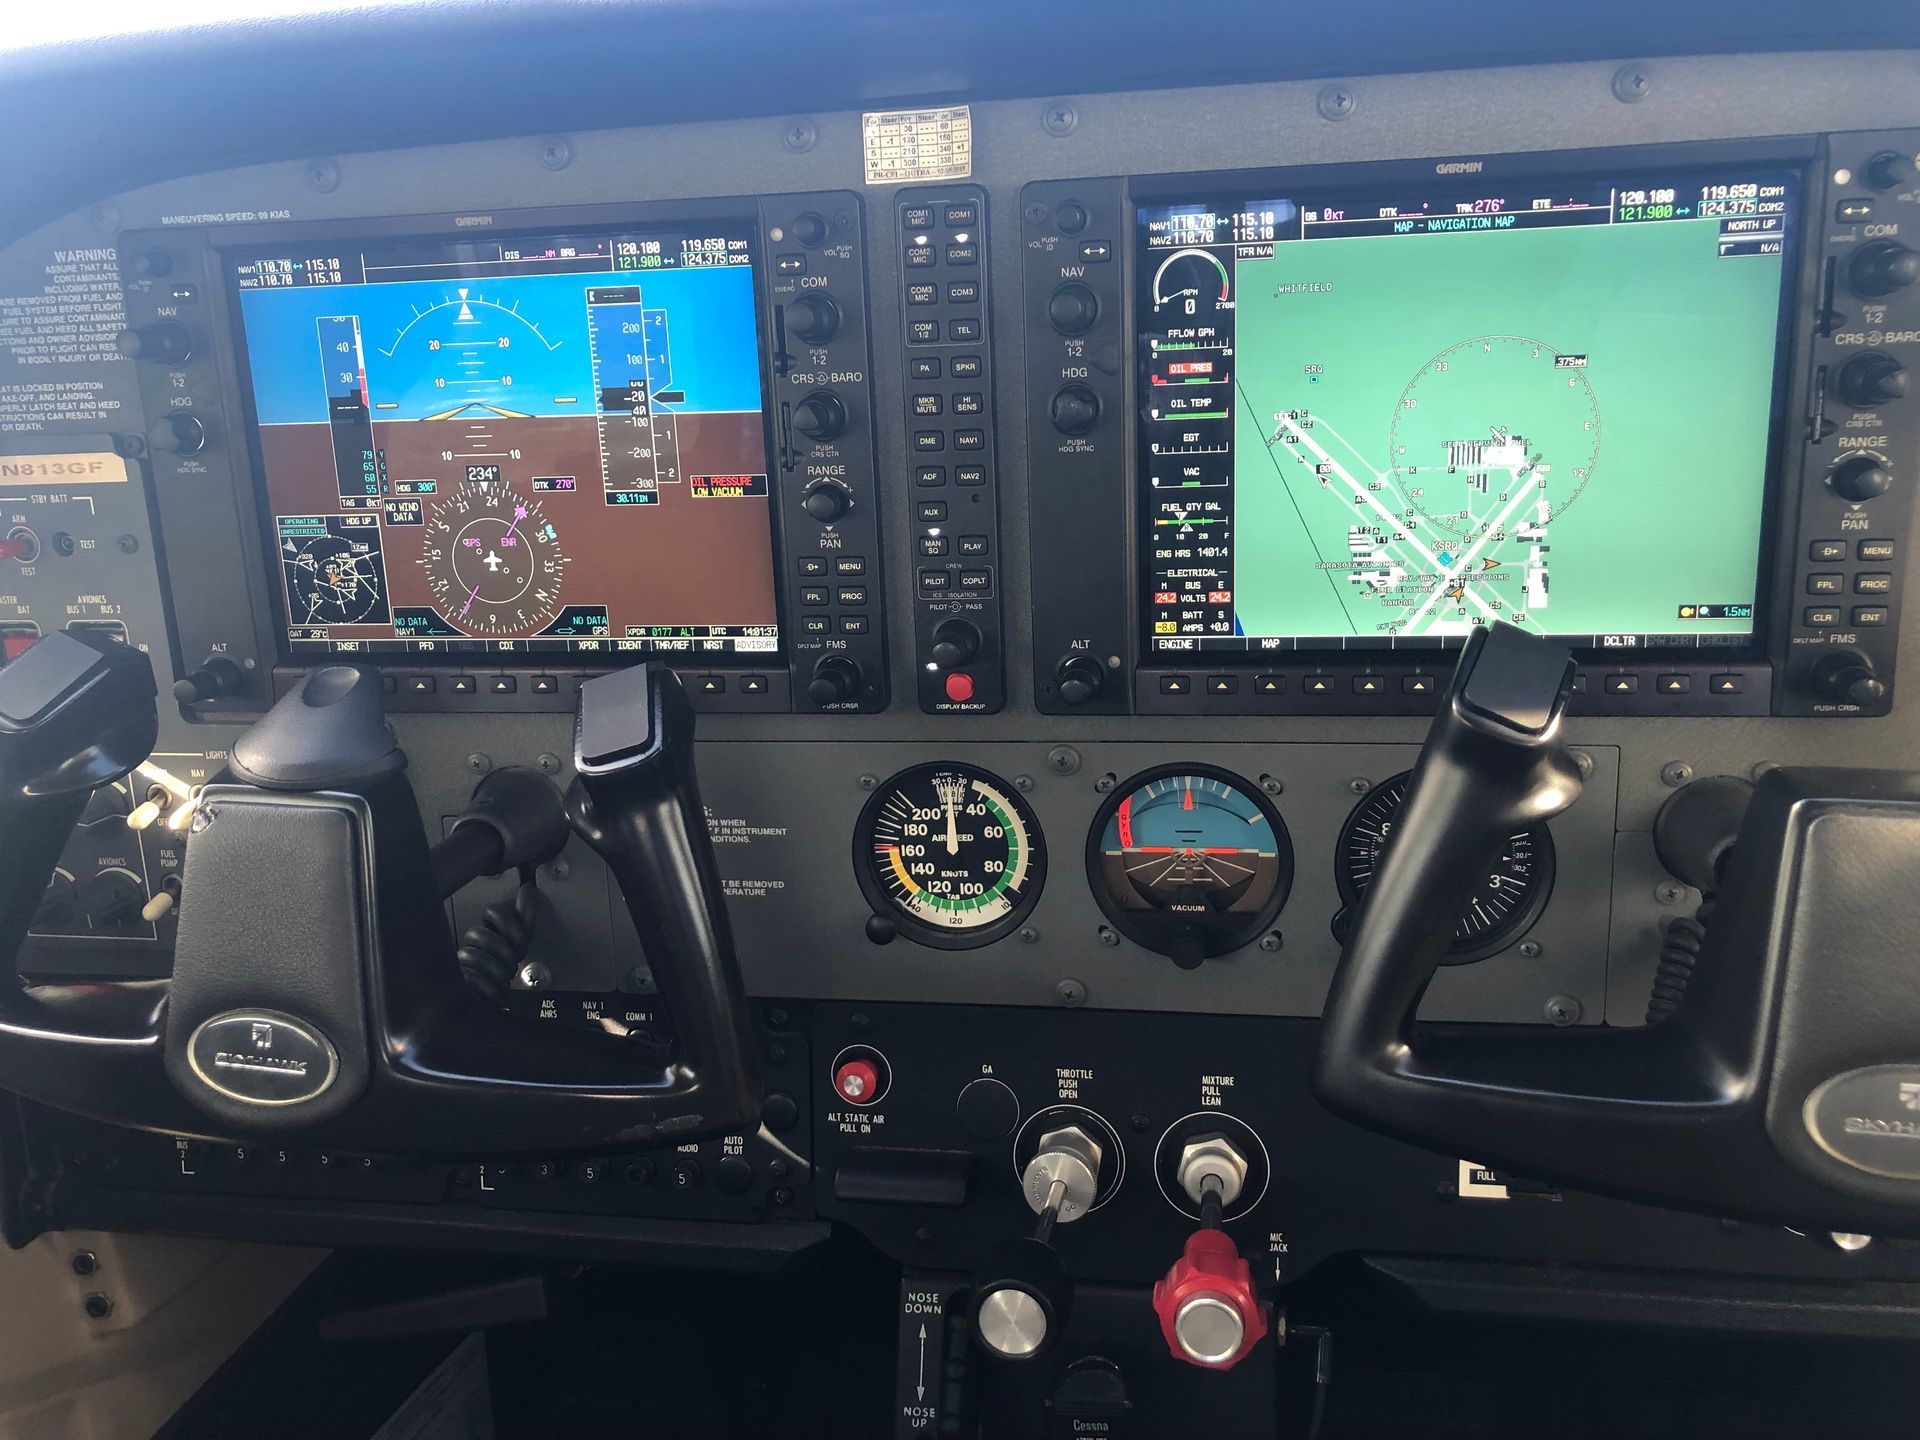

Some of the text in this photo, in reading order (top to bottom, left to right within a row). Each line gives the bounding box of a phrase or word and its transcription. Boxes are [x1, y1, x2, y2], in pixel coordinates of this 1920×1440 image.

[1436, 162, 1482, 174] GARMIN
[1620, 185, 1784, 205] 120.100 119.650 COM1
[1456, 204, 1473, 213] TRK
[1533, 199, 1550, 209] ETE
[1619, 201, 1784, 220] 121.900 124.375 COM2
[162, 216, 223, 225] MANEUVERING
[226, 213, 256, 222] SPEED:
[270, 211, 290, 219] KIAS
[908, 210, 928, 218] COM1
[949, 211, 970, 219] COM1
[1150, 213, 1274, 230] NAV1 110.70 115.10
[1394, 216, 1514, 232] MAP NAVIGATION MAP
[1728, 220, 1775, 230] NORTH UP
[1864, 225, 1897, 236] COM
[617, 239, 747, 254] 120.100 119.650 COM1
[55, 249, 116, 262] WARNING
[950, 250, 971, 258] COM2
[1238, 247, 1273, 256] TFR N/A
[619, 252, 749, 268] 121.900 124.375 COM2
[238, 259, 339, 274] NAV1 110.70 115.10
[1061, 268, 1084, 277] NAV
[801, 277, 827, 287] COM
[952, 288, 973, 296] COM3
[1279, 283, 1332, 293] WHITFIELD
[915, 324, 932, 332] COM
[920, 364, 929, 372] PA
[956, 363, 975, 371] SPKR
[1062, 368, 1087, 378] HDG
[791, 372, 862, 384] CRS BARO
[1171, 398, 1211, 408] OIL TEMP
[920, 437, 935, 445] DME
[1184, 433, 1199, 442] EGT
[1839, 436, 1887, 447] RANGE
[2, 461, 103, 476] N813GF
[808, 465, 845, 476] RANGE
[1184, 467, 1199, 475] VAC
[923, 473, 937, 481] ADF
[961, 472, 979, 480] NAV2
[692, 476, 752, 486] OIL PRESSURE
[692, 487, 743, 496] LOW VACUUM
[32, 495, 67, 503] STBY BATT
[399, 503, 418, 511] WIND
[394, 512, 413, 521] DATA
[924, 508, 939, 516] AUX
[1842, 520, 1868, 530] PAN
[80, 540, 95, 549] TEST
[820, 538, 841, 549] PAN
[964, 542, 982, 550] PLAY
[1431, 542, 1458, 551] KSRQ
[1156, 547, 1228, 558] ENG HRS 1401.4
[1864, 547, 1890, 555] MENU
[1167, 568, 1218, 577] ELECTRICAL
[963, 577, 985, 585] COPLT
[1860, 580, 1887, 588] PROC
[78, 595, 106, 604] AVIONICS
[808, 593, 820, 601] FPL
[841, 592, 862, 600] PROC
[1183, 611, 1203, 619] BATT
[1862, 613, 1879, 621] ENT
[808, 622, 823, 630] CLR
[846, 622, 860, 630] ENT
[1604, 636, 1635, 646] DCLTR
[1830, 634, 1856, 643] FMS
[337, 642, 360, 651] INSET
[419, 641, 434, 650] PFD
[499, 641, 514, 650] CDI
[579, 641, 599, 650] XPDR
[618, 641, 642, 650] IDENT
[655, 640, 689, 649] TMR/REF
[704, 640, 723, 649] NRST
[737, 640, 776, 649] ADVISORY
[827, 640, 847, 649] FMS
[1071, 640, 1090, 649] ALT
[1160, 639, 1192, 649] ENGINE
[1262, 639, 1279, 648] MAP
[912, 808, 940, 820] 200
[966, 804, 986, 816] 40
[904, 824, 927, 836] 180
[984, 826, 1003, 838] 60
[901, 844, 924, 856] 160
[911, 863, 934, 875] 140
[984, 861, 1003, 872] 80
[928, 881, 951, 893] 120
[960, 883, 983, 895] 100
[1171, 904, 1205, 912] VACUUM
[542, 1001, 555, 1009] ADC
[541, 1009, 557, 1018] AHRS
[982, 1065, 992, 1073] GA
[1056, 1068, 1093, 1079] THROTTLE
[1059, 1080, 1078, 1088] PUSH
[1202, 1076, 1234, 1086] MIXTURE
[1059, 1090, 1077, 1098] OPEN
[1202, 1086, 1220, 1096] PULL
[1202, 1096, 1220, 1106] LEAN
[828, 1113, 884, 1124] ALT STATIC AIR
[840, 1123, 870, 1133] PULL ON
[724, 1137, 744, 1145] AUTO
[723, 1145, 744, 1154] PILOT
[1477, 1171, 1495, 1180] FULL
[1270, 1234, 1282, 1242] MIC
[1270, 1243, 1288, 1253] JACK
[908, 1293, 939, 1304] NOSE
[905, 1304, 942, 1314] DOWN
[904, 1408, 935, 1418] NOSE
[912, 1418, 926, 1428] UP
[1074, 1420, 1108, 1432] Cessna
